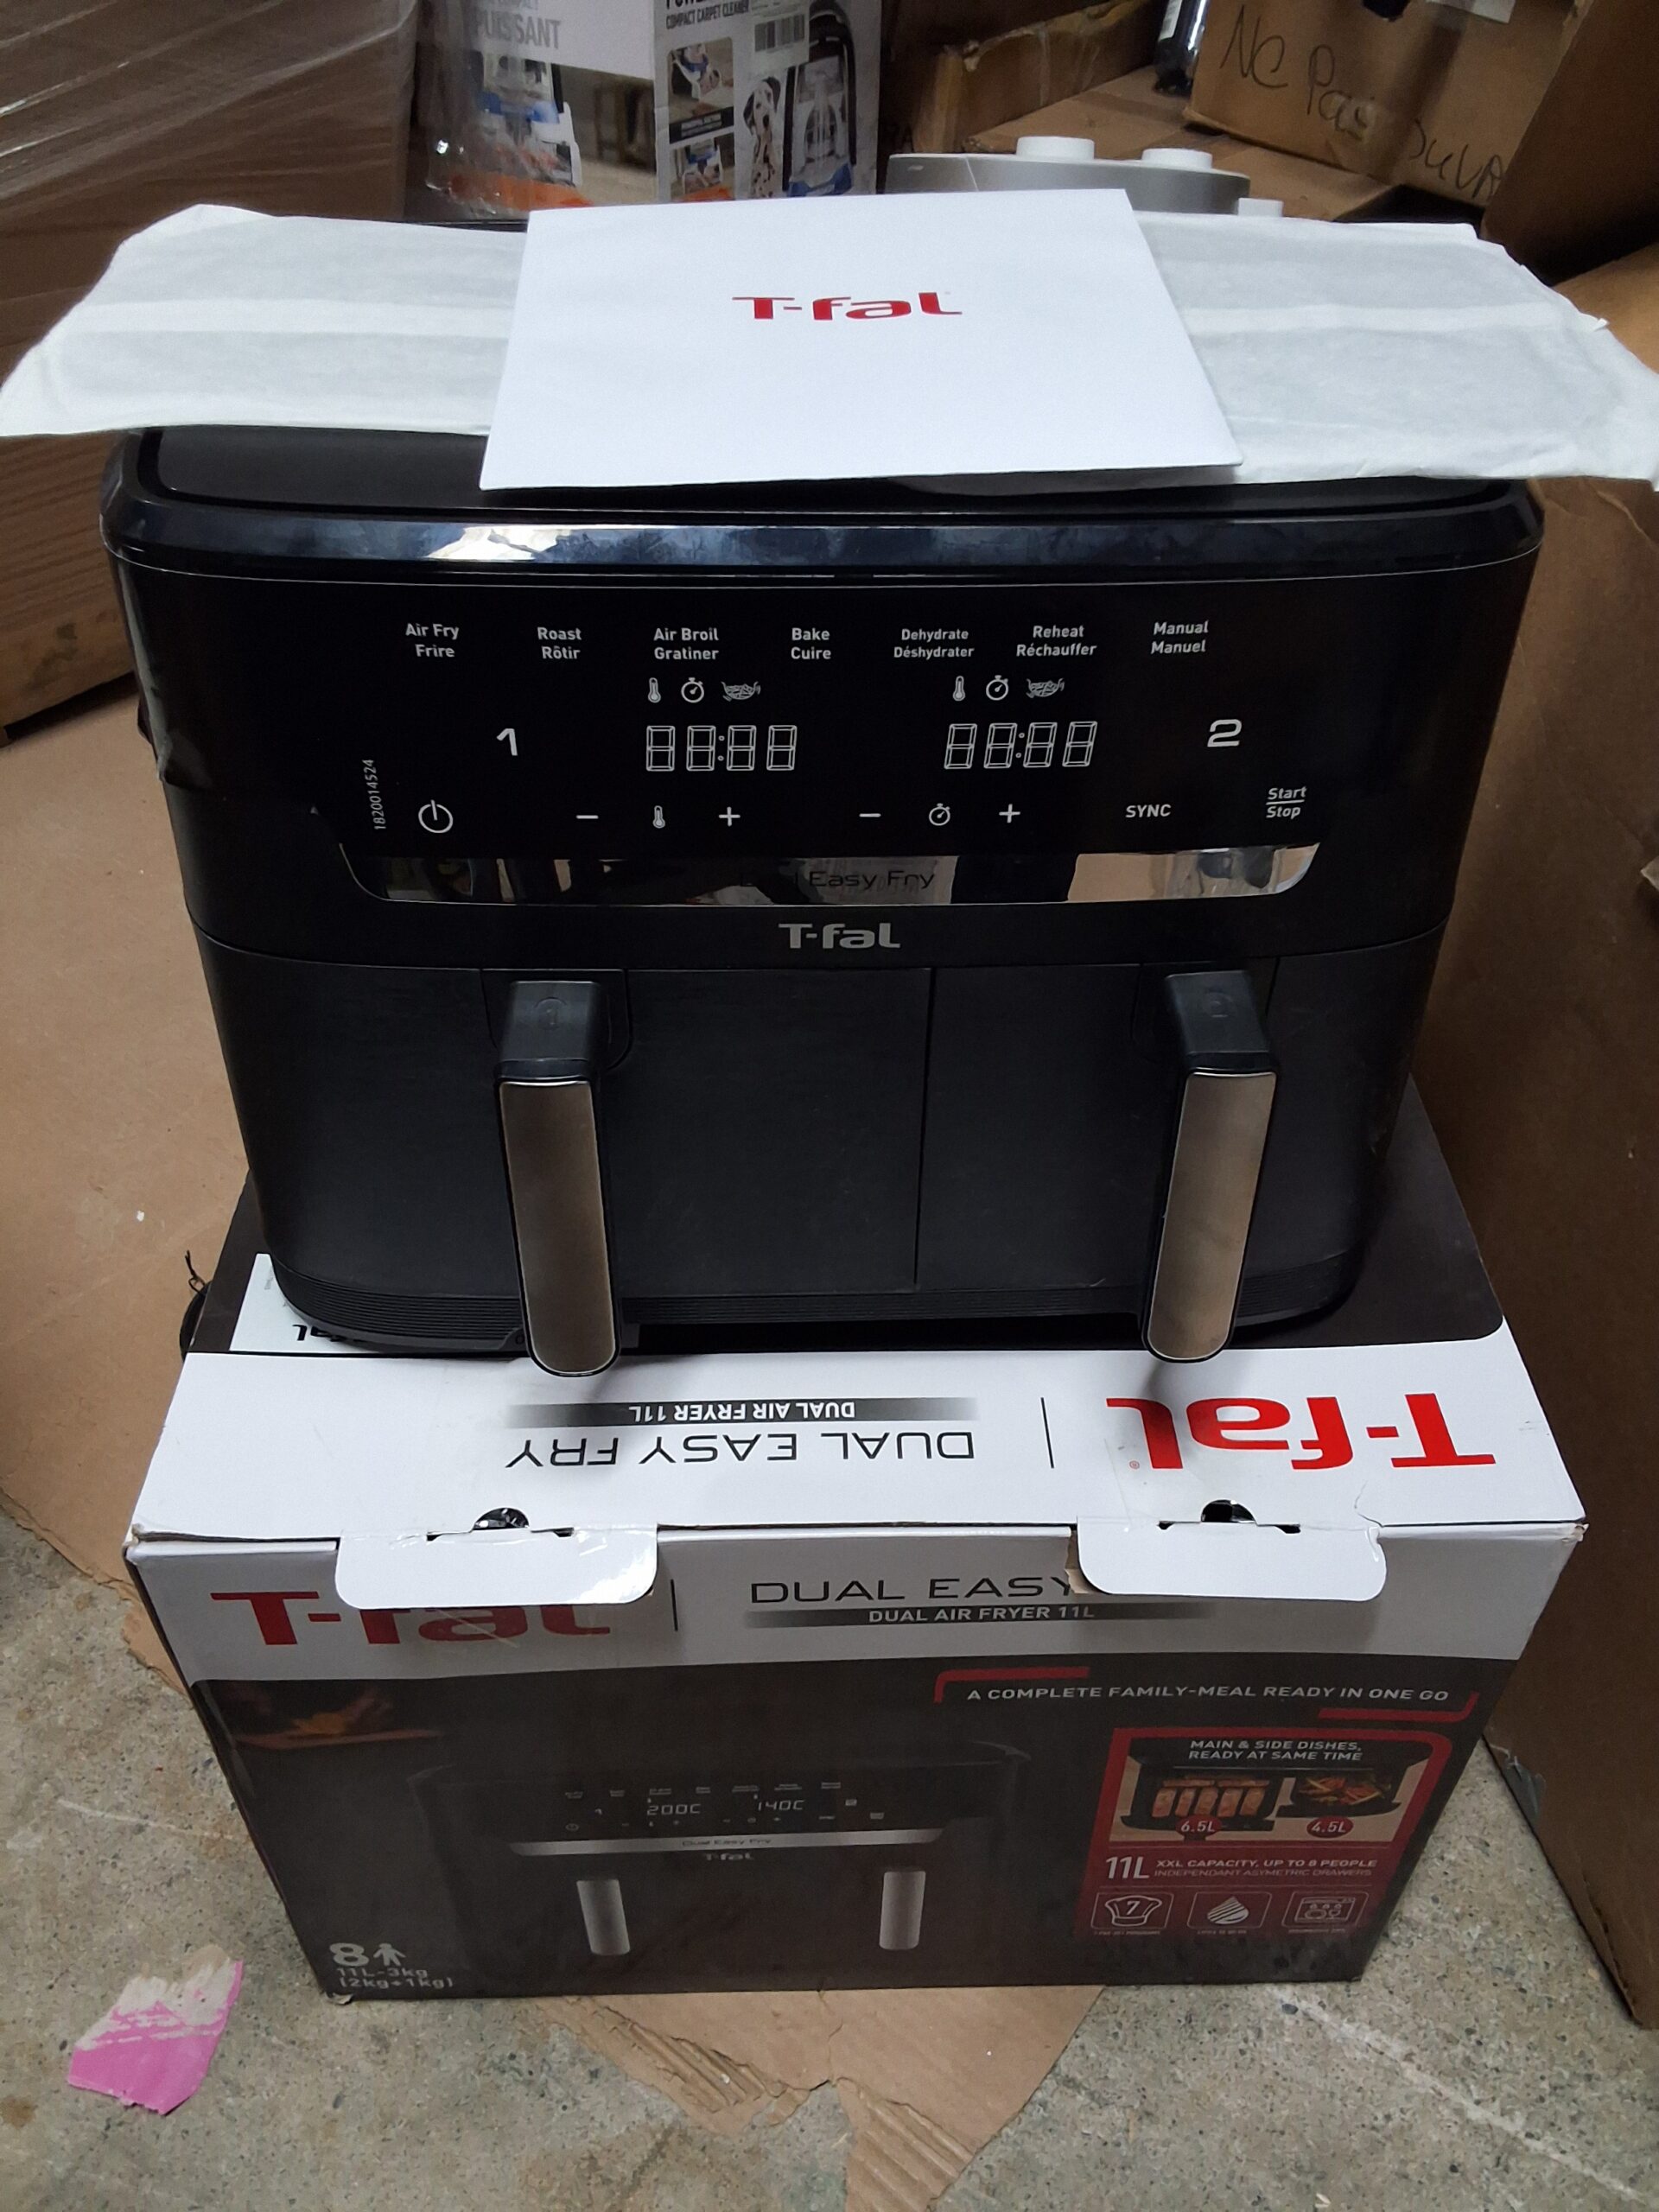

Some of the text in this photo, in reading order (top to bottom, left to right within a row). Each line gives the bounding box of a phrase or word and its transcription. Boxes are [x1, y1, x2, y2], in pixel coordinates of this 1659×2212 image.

[665, 9, 696, 29] COMPACT
[696, 3, 721, 23] CARPET
[732, 292, 963, 321] T-fal
[405, 623, 459, 639] Air Fry
[537, 627, 582, 641] Roast
[654, 628, 719, 641] Air Broil
[791, 627, 830, 641] Bake
[901, 627, 969, 643] Dehydrate
[1033, 626, 1084, 639] Reheat
[1154, 621, 1209, 635] Manual
[415, 644, 454, 658] Frire
[542, 645, 581, 659] Rôtir
[654, 646, 719, 659] Gratiner
[791, 646, 831, 660] Cuire
[893, 645, 975, 659] Déshydrater
[1016, 642, 1096, 658] Réchauffer
[1151, 639, 1206, 654] Manuel
[1208, 719, 1242, 747] 2
[497, 728, 518, 756] 1
[362, 759, 386, 830] 1820014524
[1268, 786, 1306, 799] Start
[1126, 804, 1171, 818] SYNC
[1267, 805, 1300, 819] Stop
[809, 871, 877, 890] Easy
[887, 871, 935, 890] Fry
[778, 923, 900, 950] T-fal
[628, 1402, 855, 1422] DUAL AIR FRYER 11L
[1106, 1392, 1496, 1471] T-fal
[505, 1432, 974, 1468] DUAL EASY FRY
[751, 1576, 1071, 1604] DUAL EASY
[868, 1605, 1095, 1623] DUAL AIR FRYER 11L
[967, 1686, 1449, 1701] A COMPLETE FAMILY-MEAL READY IN ONE GO
[1191, 1740, 1362, 1751] MAIN & SIDE DISHES,
[1188, 1751, 1363, 1761] READY AT SAME TIME
[1181, 1820, 1215, 1833] 6.5L
[1311, 1820, 1346, 1833] 4.5L
[1106, 1857, 1149, 1878] 11L
[1187, 1859, 1259, 1868] CAPACITY,
[1321, 1859, 1377, 1867] PEOPLE
[329, 1942, 371, 1967] 8
